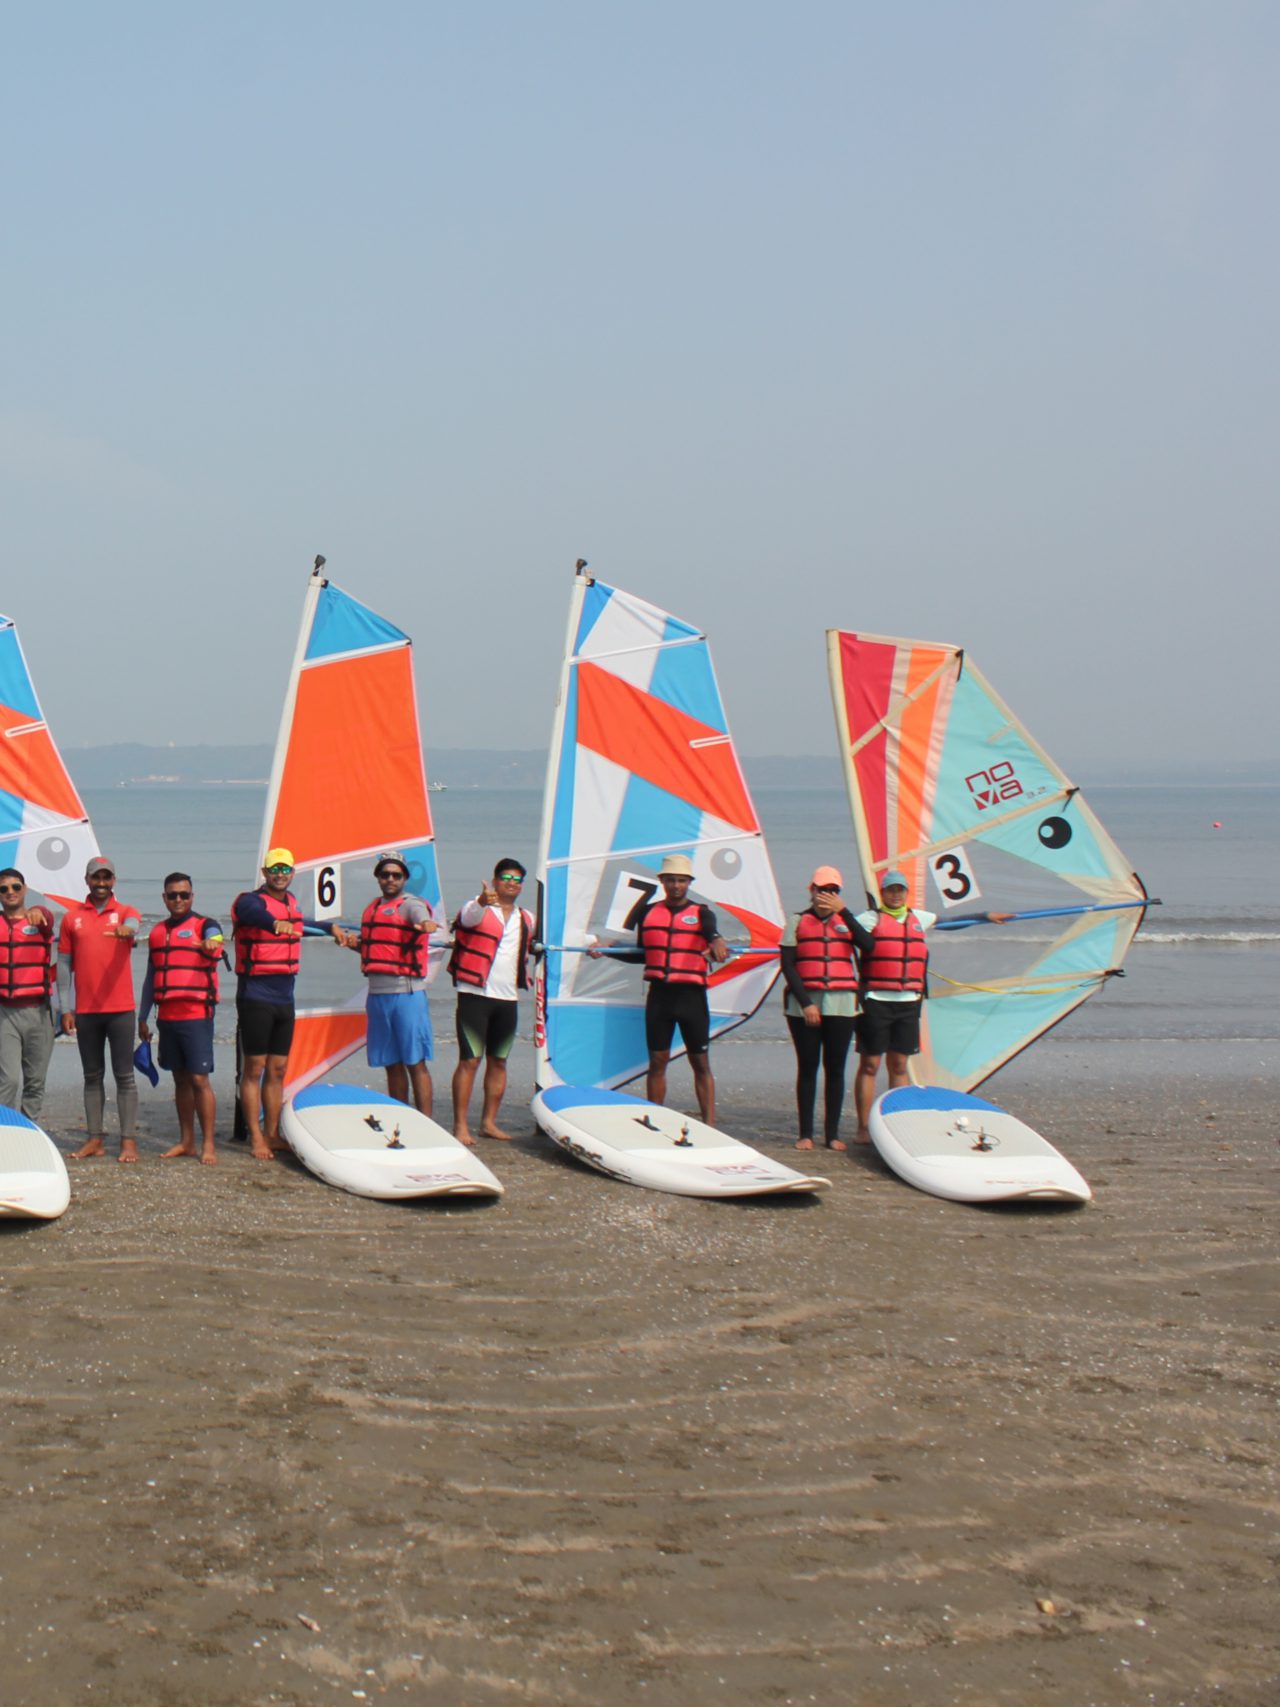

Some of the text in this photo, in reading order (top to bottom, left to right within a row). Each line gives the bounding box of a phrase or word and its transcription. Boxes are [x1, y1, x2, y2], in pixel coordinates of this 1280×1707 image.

[318, 867, 336, 907] 6
[935, 854, 970, 900] 3
[623, 878, 658, 931] 7
